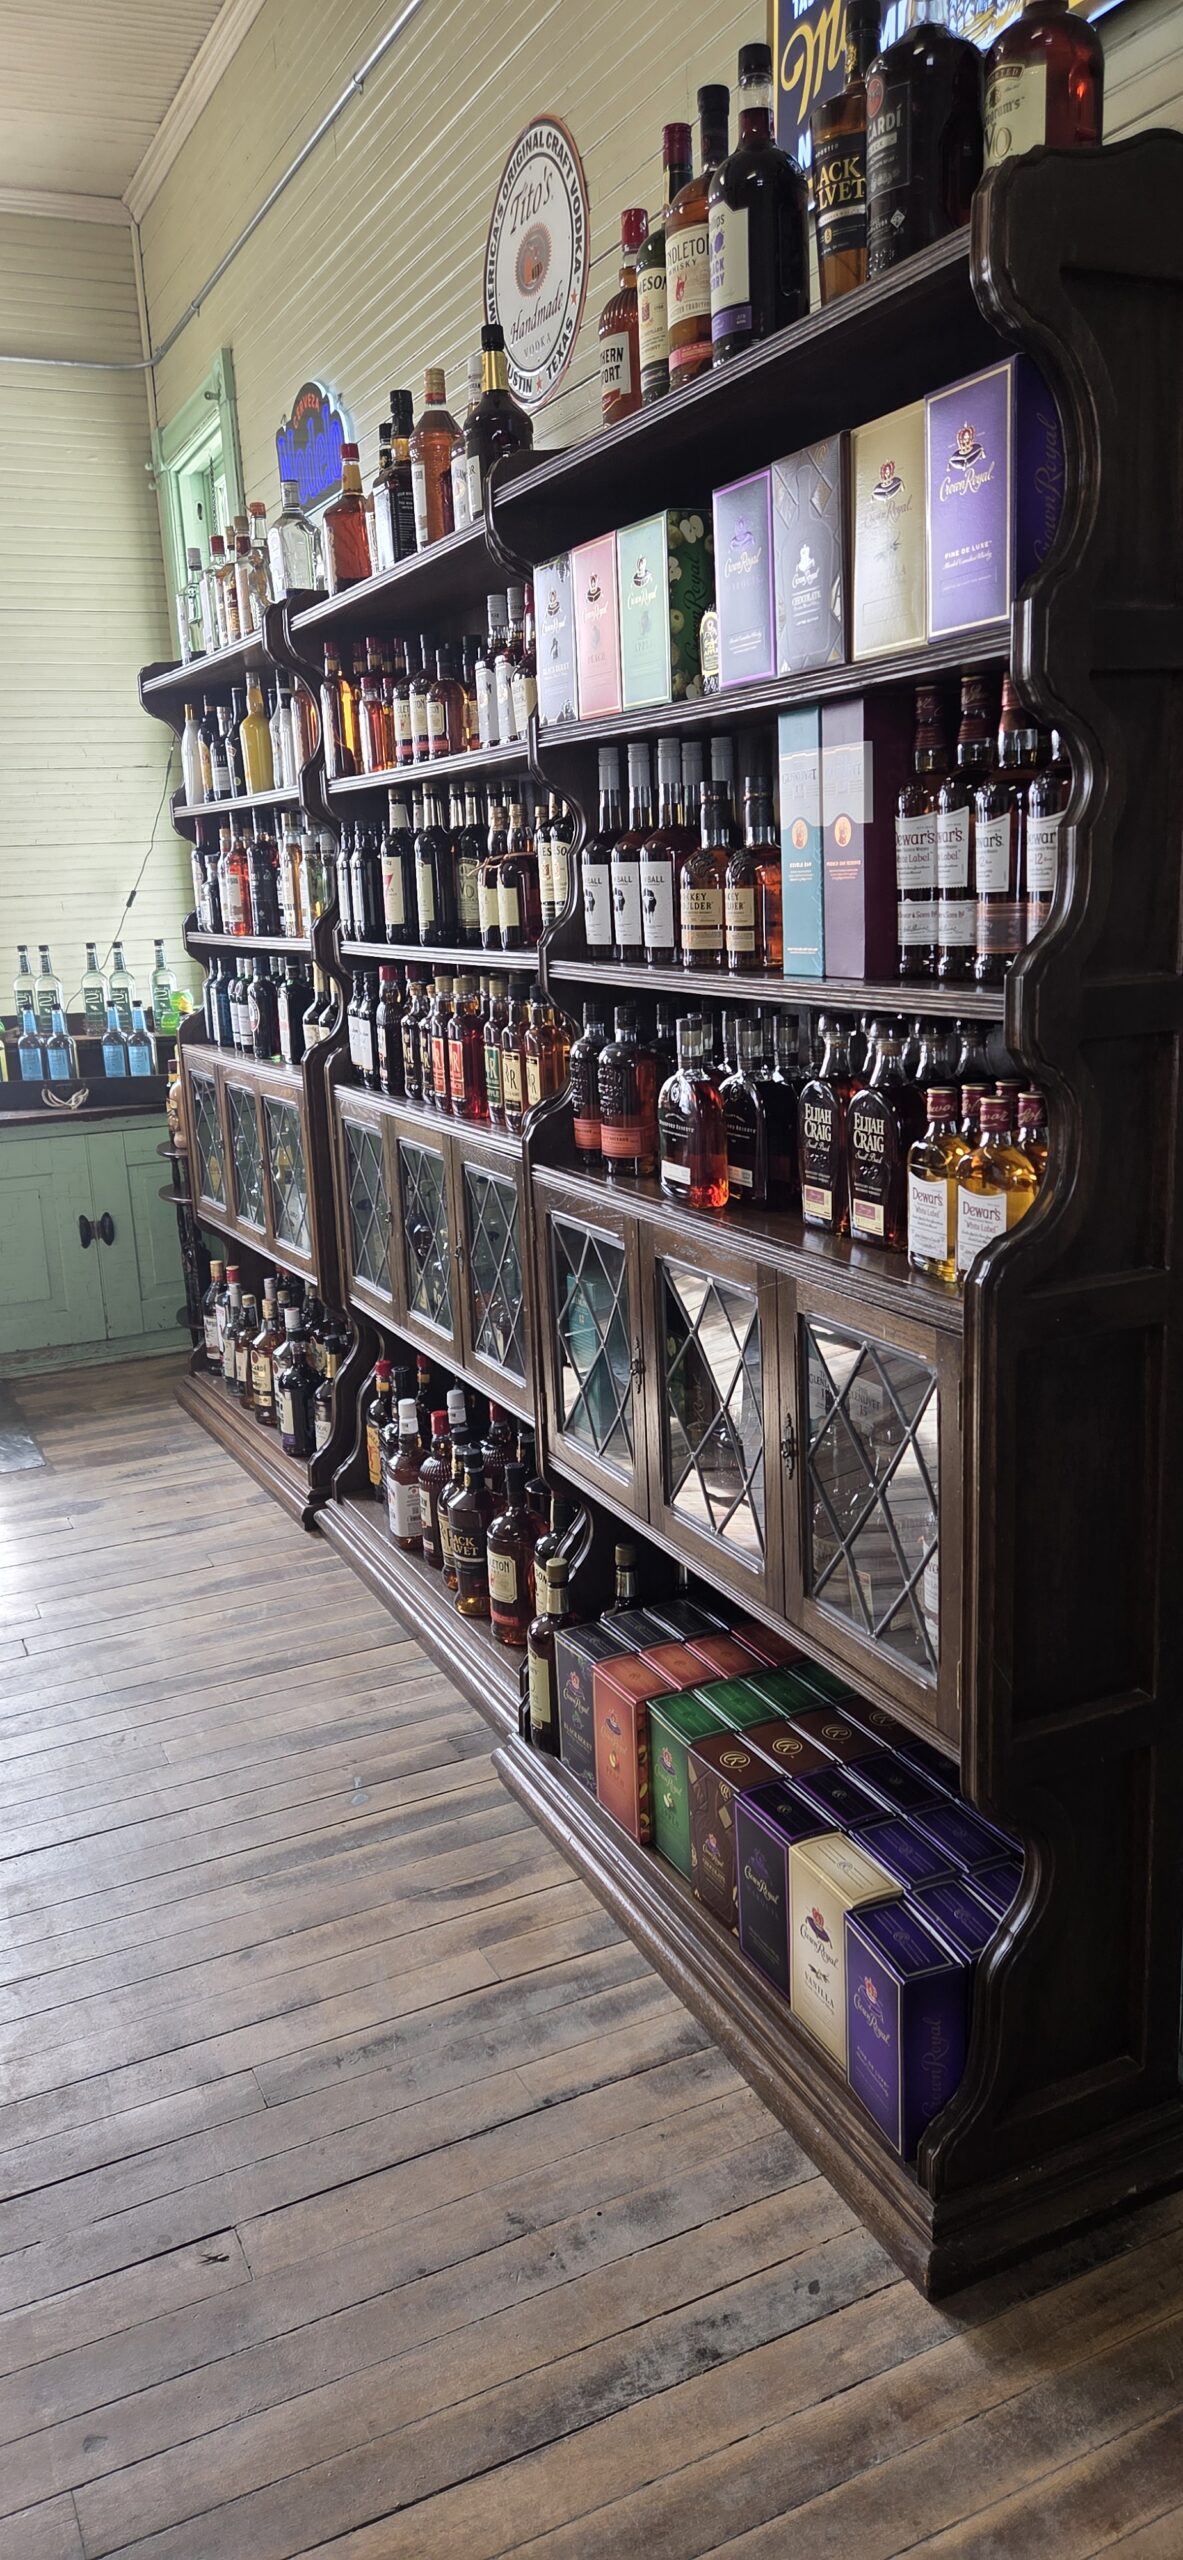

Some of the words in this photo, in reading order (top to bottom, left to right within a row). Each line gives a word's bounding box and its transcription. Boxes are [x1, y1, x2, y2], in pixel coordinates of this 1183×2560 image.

[510, 166, 553, 235] Tito's
[487, 203, 504, 323] MERICA'S
[502, 131, 545, 201] ORIGINAL
[546, 131, 574, 180] CRAFT
[570, 177, 584, 275] VODKA
[510, 280, 564, 345] Handmade
[545, 316, 573, 380] TEXAS
[293, 393, 320, 429] CERVEZA
[804, 1103, 832, 1125] ELIJAH
[853, 1112, 885, 1135] ELIJAH
[804, 1120, 832, 1142] CRAIG
[853, 1131, 884, 1153] CRAIG
[912, 1187, 943, 1206] Dewar's
[963, 1201, 1001, 1221] Dewar's
